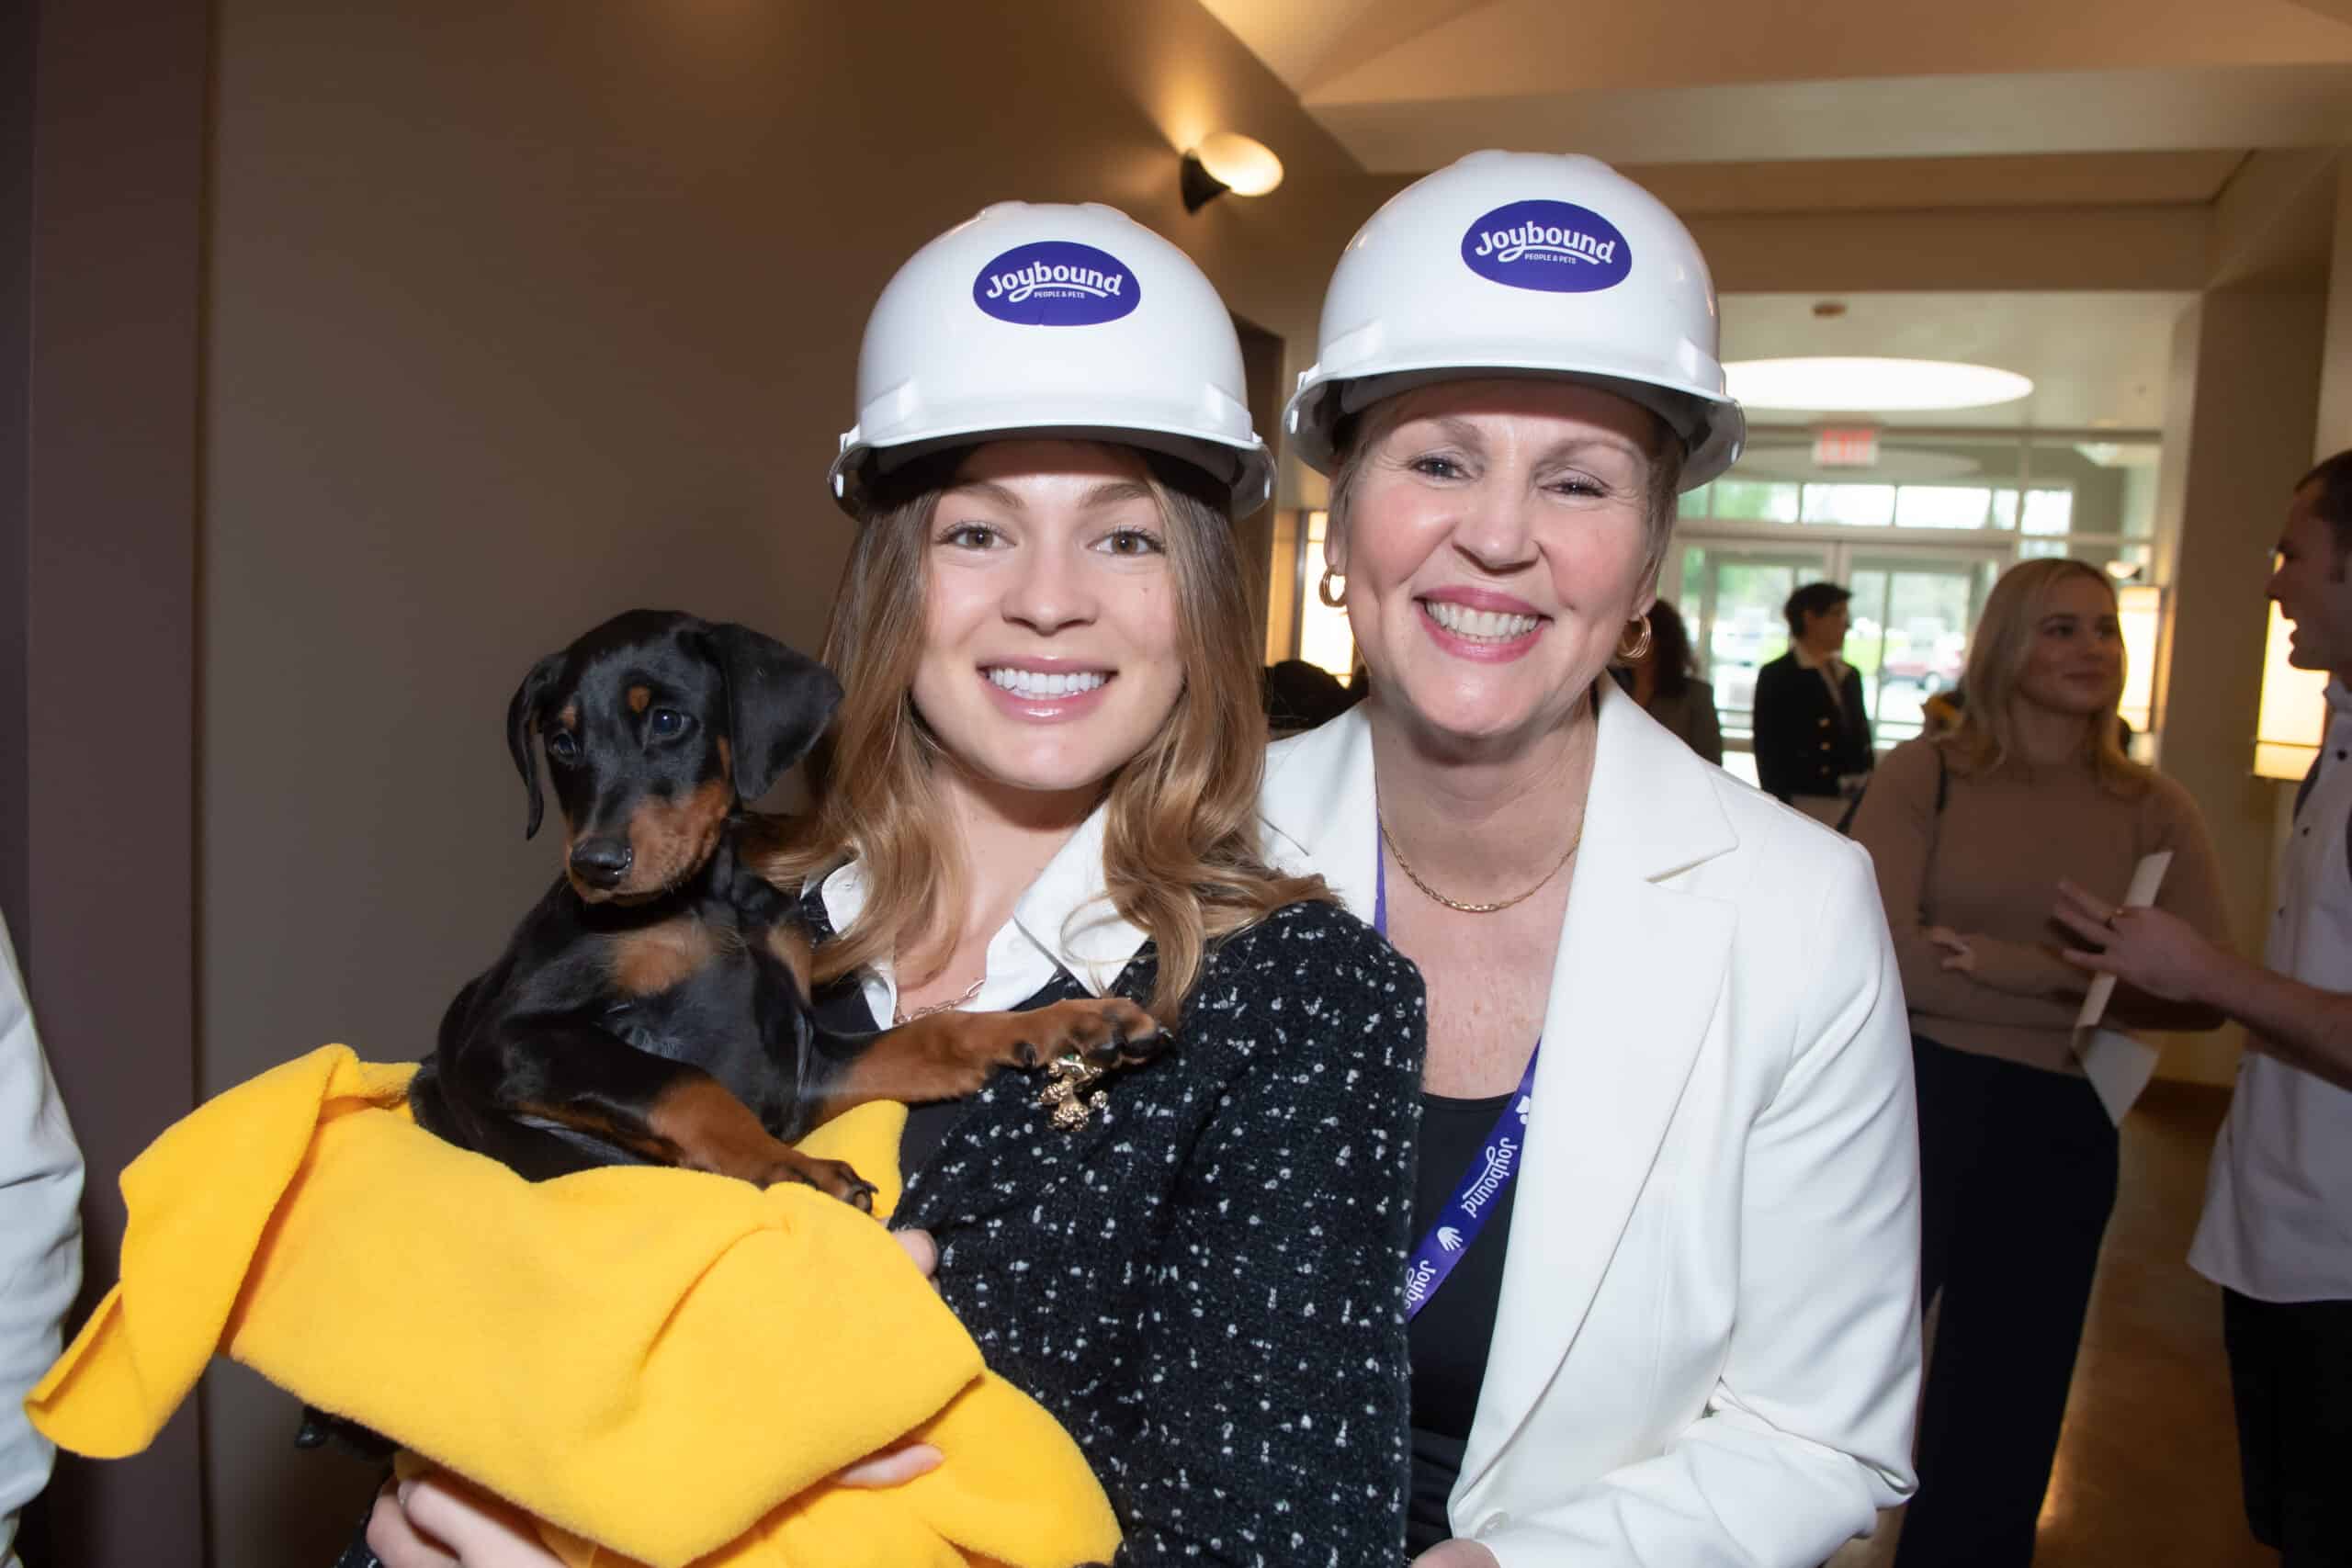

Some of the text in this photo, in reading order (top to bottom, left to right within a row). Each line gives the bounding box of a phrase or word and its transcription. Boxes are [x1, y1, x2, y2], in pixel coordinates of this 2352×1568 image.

[1475, 220, 1616, 265] Joybound
[1524, 253, 1552, 262] PEOPLE
[1559, 255, 1577, 265] PETS
[986, 261, 1123, 303] Joybound
[1034, 290, 1060, 299] PEOPLE
[1461, 1137, 1518, 1219] Joybound
